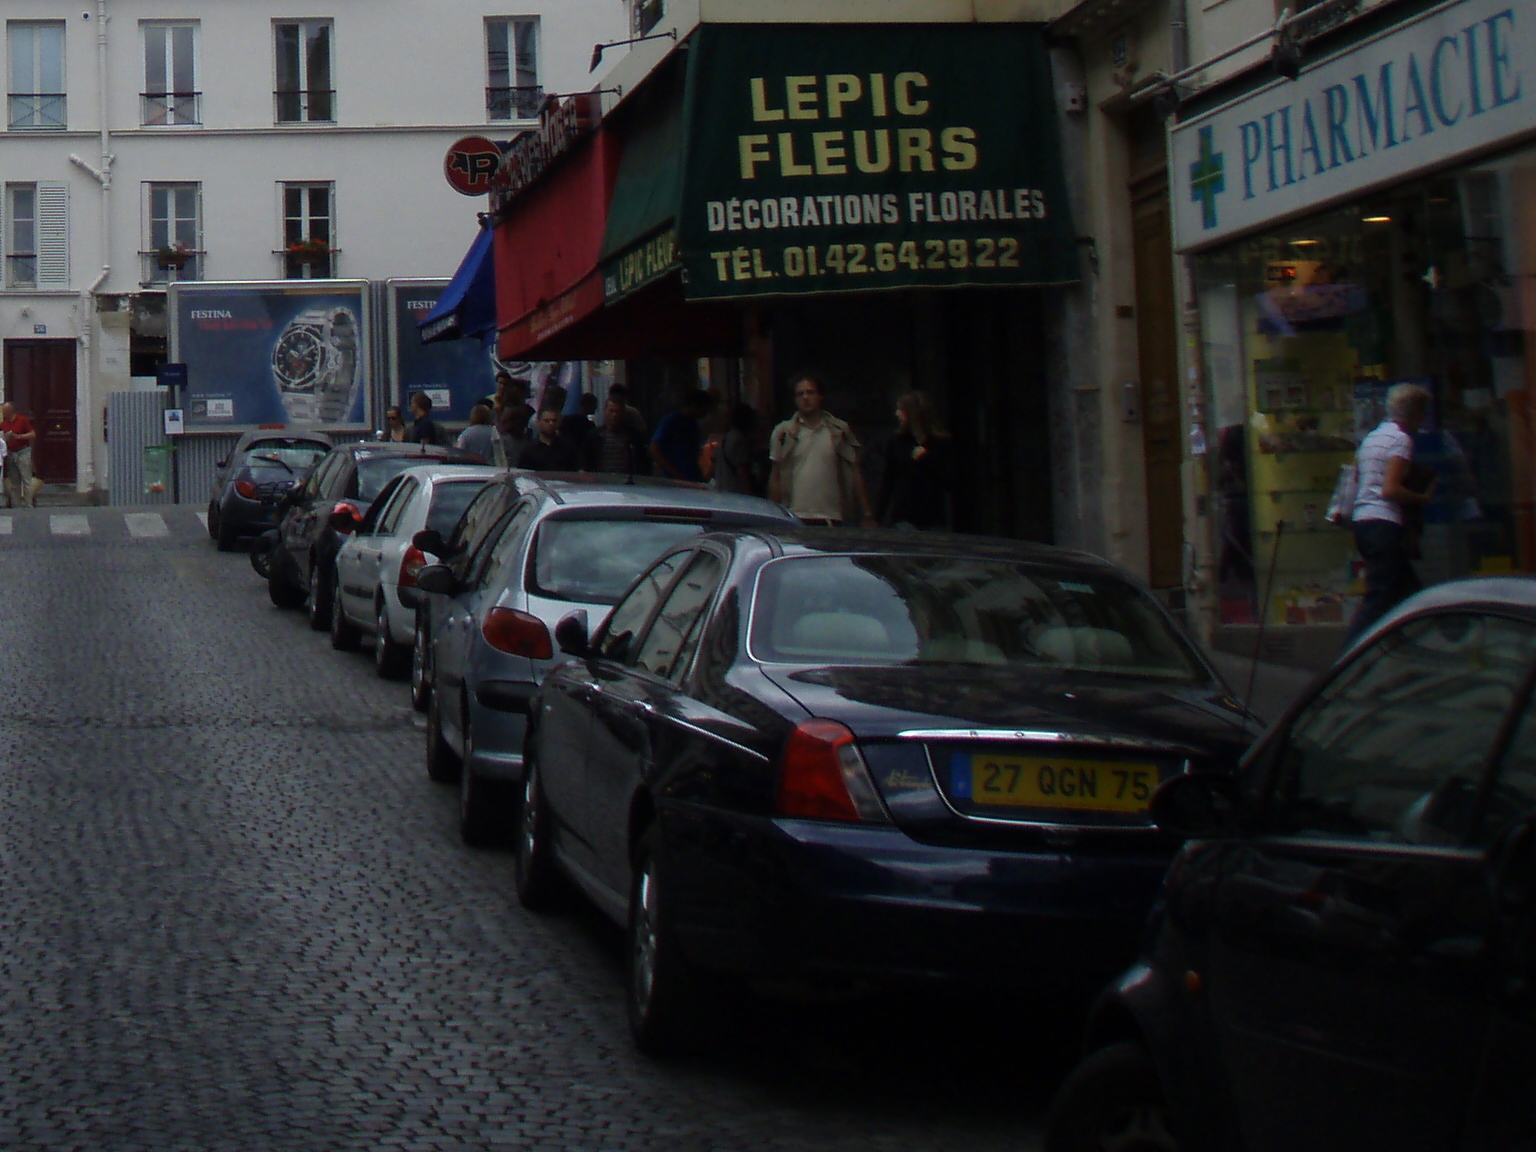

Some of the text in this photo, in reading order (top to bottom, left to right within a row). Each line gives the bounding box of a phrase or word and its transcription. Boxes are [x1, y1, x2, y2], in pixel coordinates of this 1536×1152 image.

[749, 71, 930, 123] LEPIC
[1238, 9, 1522, 201] PHARMACIE
[738, 126, 979, 180] FLEURS
[706, 188, 1047, 232] DÉCORATIONS FLORALES
[191, 310, 232, 319] FESTINA
[983, 762, 1150, 801] 27 QGN 75
